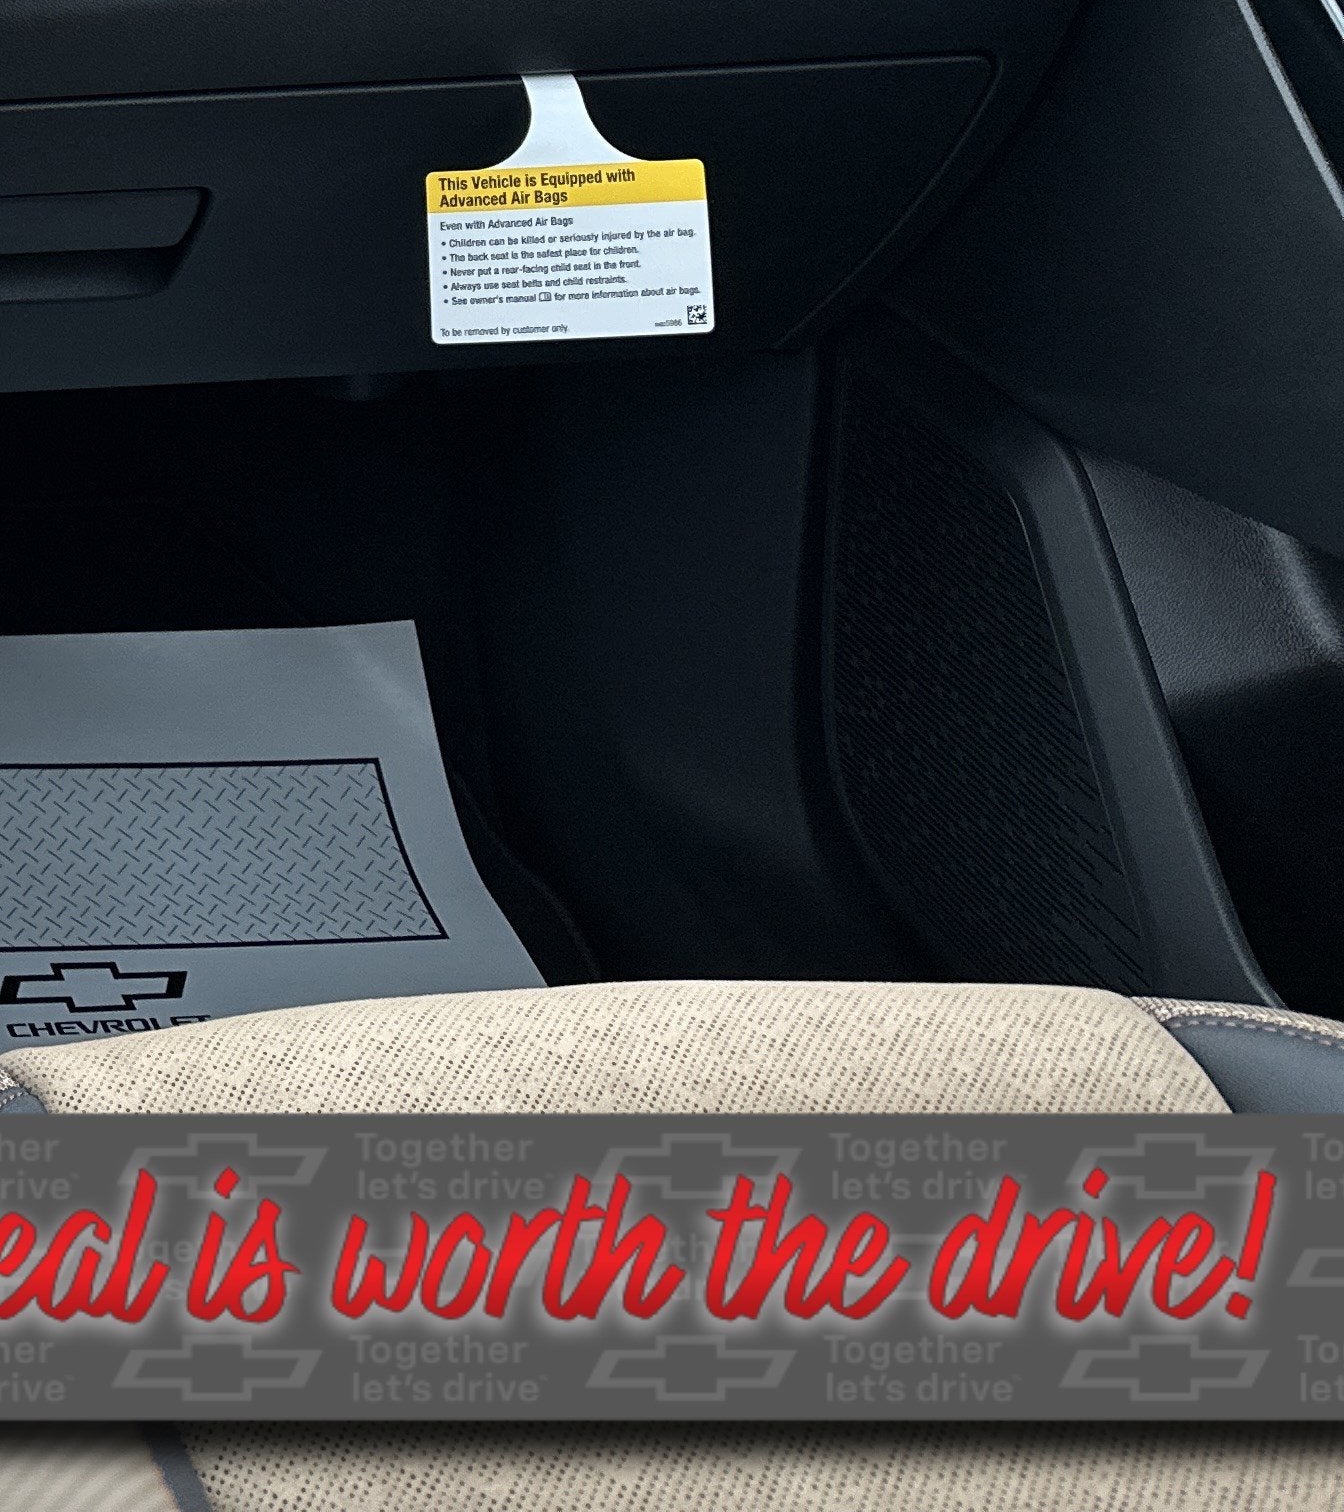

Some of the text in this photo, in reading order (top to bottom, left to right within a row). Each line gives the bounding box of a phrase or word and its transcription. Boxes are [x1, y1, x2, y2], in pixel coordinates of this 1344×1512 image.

[438, 168, 635, 191] This Vehicle is Equipped with
[439, 190, 568, 208] Advanced Air Bags
[440, 216, 574, 231] Even with Advanced Air Bags
[449, 238, 486, 248] Children
[489, 238, 505, 246] can
[507, 237, 519, 246] be
[521, 235, 545, 245] killed
[548, 236, 557, 244] or
[560, 233, 599, 243] seriously
[601, 231, 632, 241] injured
[634, 230, 645, 240] by
[647, 229, 660, 238] the
[663, 229, 675, 237] air
[449, 253, 465, 262] The
[468, 252, 489, 261] back
[491, 251, 509, 261] seat
[511, 251, 519, 259] is
[521, 250, 534, 259] the
[537, 249, 562, 258] safest
[564, 248, 587, 258] place
[589, 247, 601, 256] for
[450, 268, 475, 277] Never
[477, 267, 492, 277] put
[501, 264, 549, 275] rear-facing
[551, 263, 571, 272] child
[573, 262, 591, 271] seat
[593, 261, 601, 270] in
[604, 261, 617, 269] the
[451, 282, 481, 292] Always
[484, 282, 499, 290] use
[501, 280, 520, 289] seat
[522, 279, 542, 288] belts
[545, 278, 560, 287] and
[563, 277, 583, 286] child
[452, 296, 468, 305] See
[470, 295, 504, 305] owner's
[506, 294, 536, 303] manual
[554, 292, 566, 301] for
[568, 291, 589, 300] more
[592, 289, 638, 299] information
[641, 288, 664, 297] about
[666, 287, 677, 295] air
[440, 328, 450, 337] To
[452, 328, 462, 336] be
[464, 327, 499, 336] removed
[501, 326, 511, 336] by
[513, 325, 550, 334] customer
